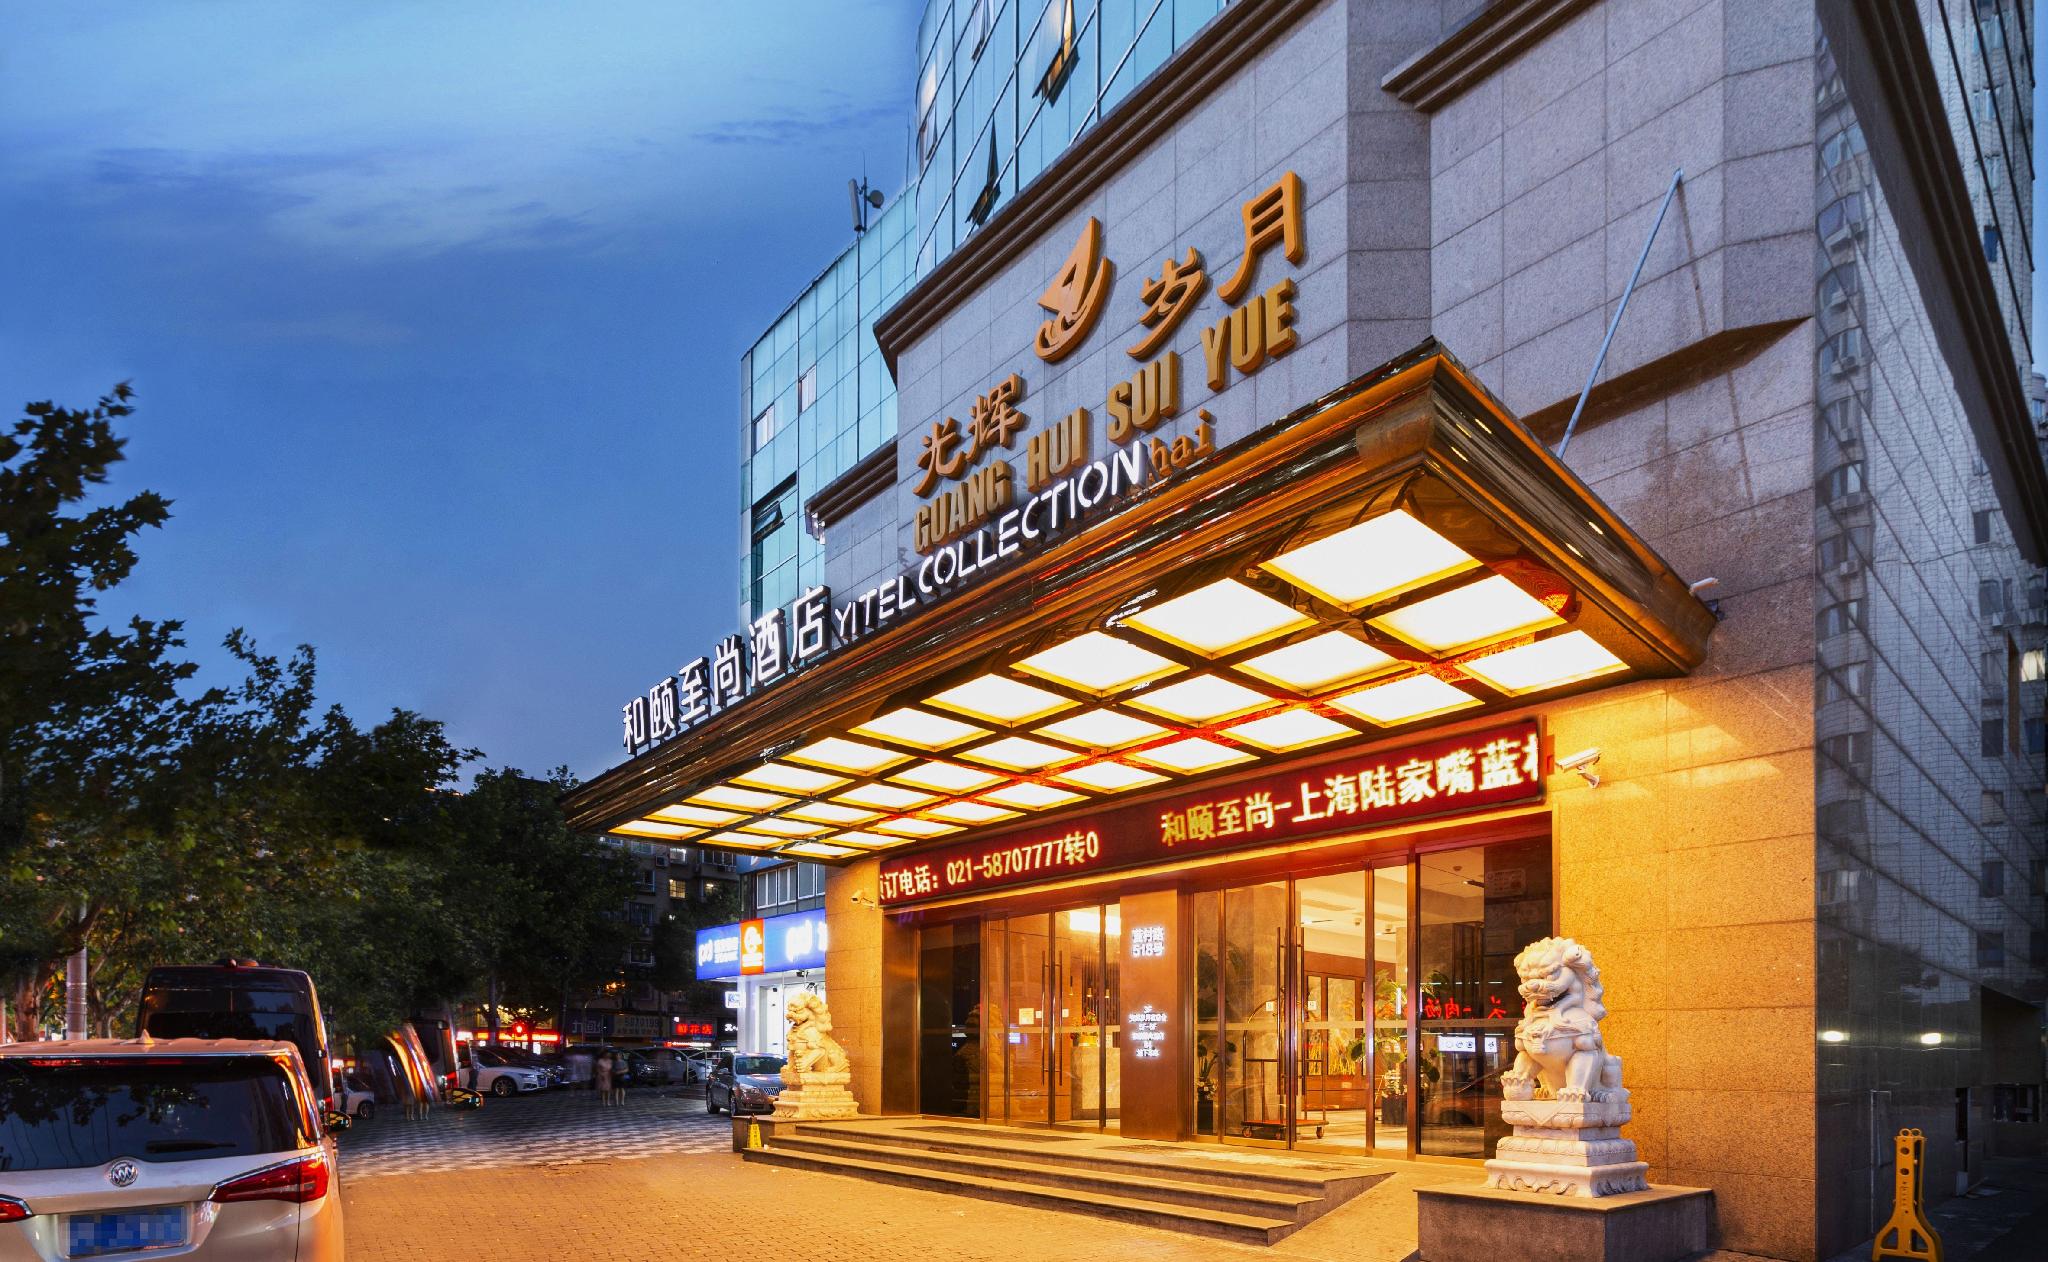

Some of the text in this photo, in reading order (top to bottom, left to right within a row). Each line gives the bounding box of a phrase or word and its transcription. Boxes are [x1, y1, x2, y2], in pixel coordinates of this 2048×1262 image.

[913, 170, 1303, 498] 光辉 岁月
[913, 277, 1297, 556] GUANG HUI SUI YUE
[622, 440, 1142, 755] 和颐至尚酒店 YITEL COLLECTION
